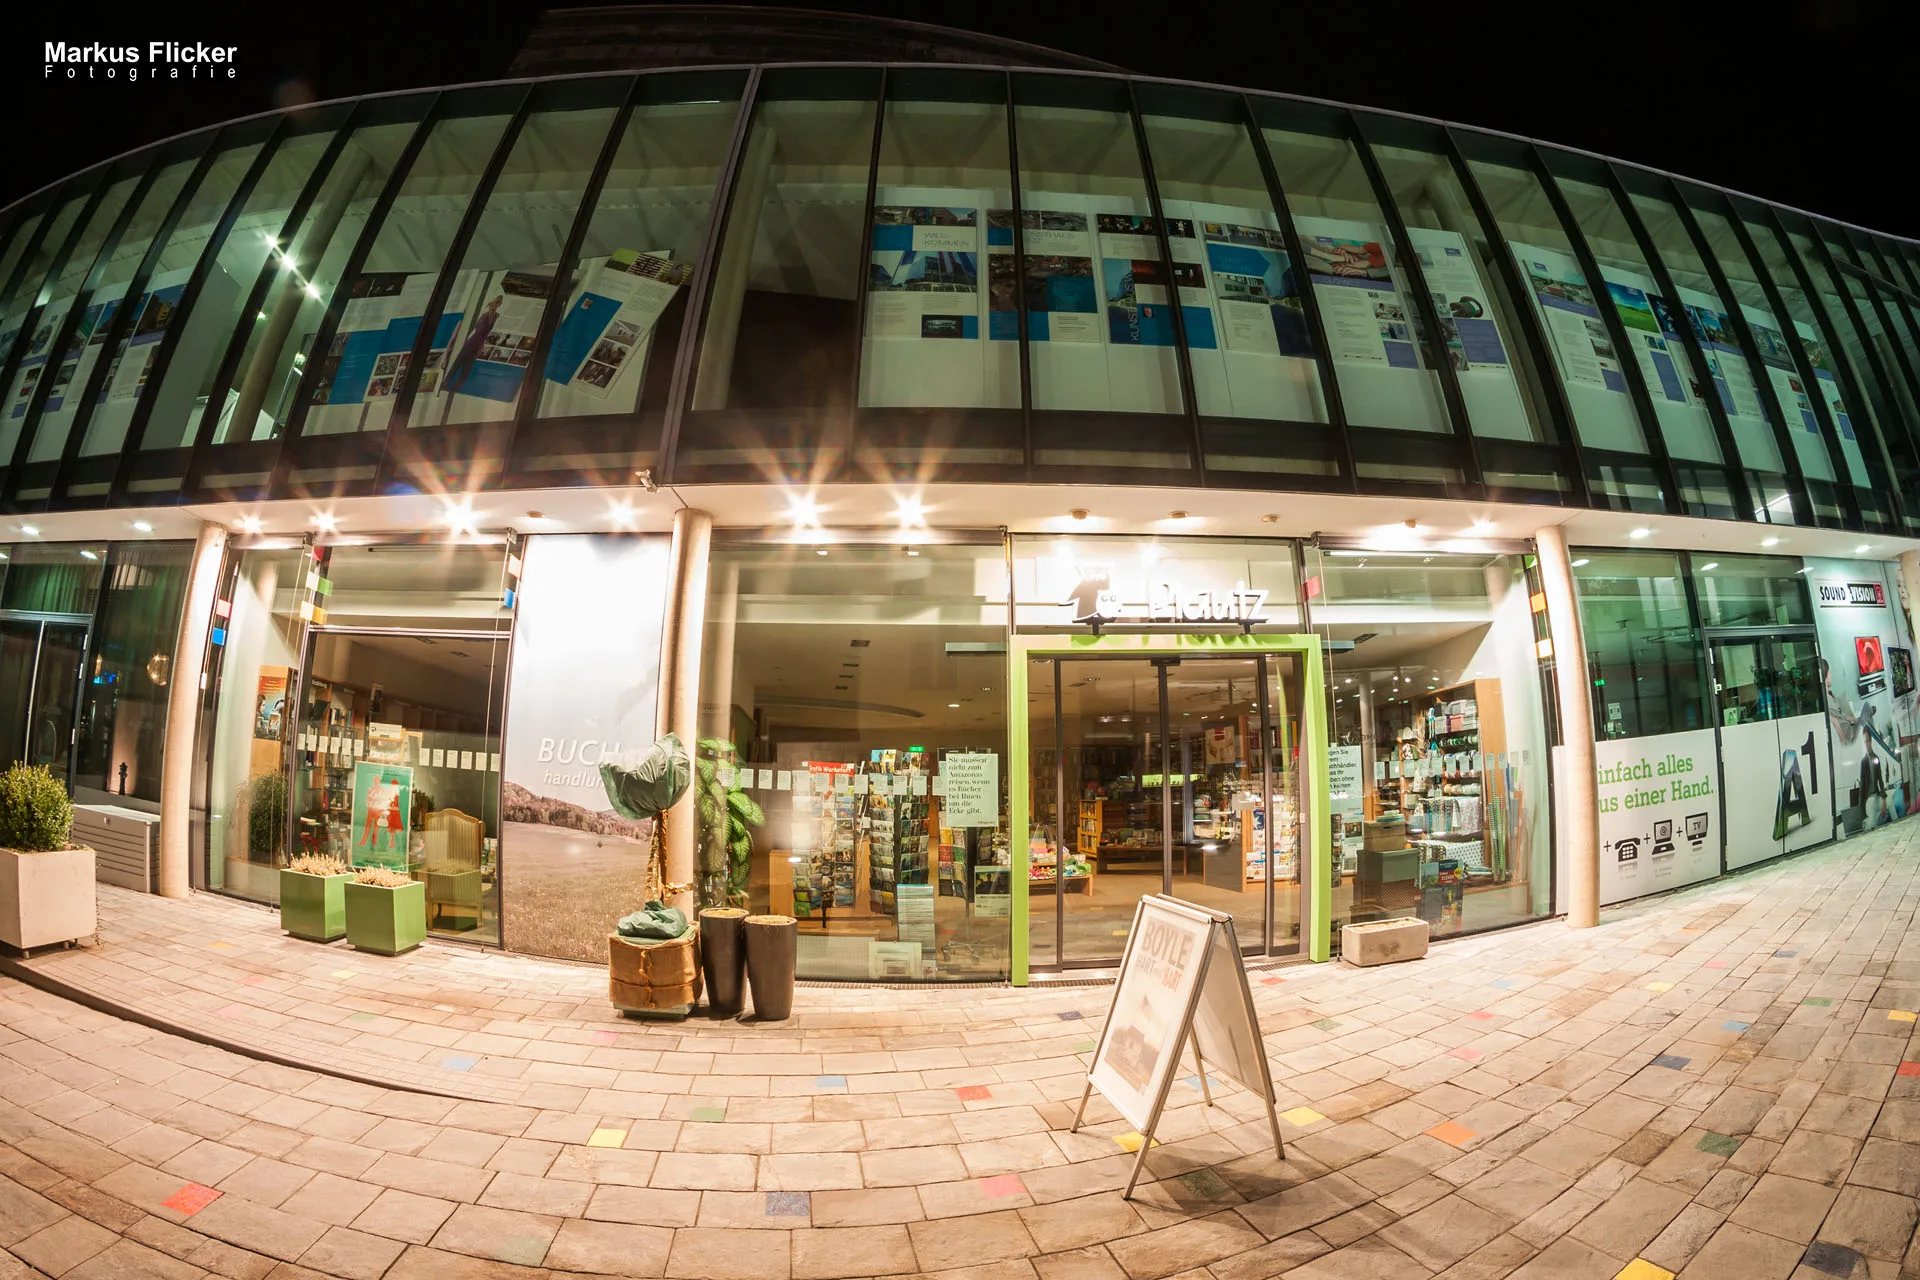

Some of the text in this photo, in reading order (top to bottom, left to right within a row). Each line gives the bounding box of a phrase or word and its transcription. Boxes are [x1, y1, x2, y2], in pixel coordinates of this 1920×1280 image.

[1149, 580, 1271, 621] Plautz
[1820, 586, 1846, 600] SOUND
[538, 737, 621, 767] BUCH
[1598, 754, 1693, 784] infach alles
[1598, 775, 1714, 813] us einer Hand.
[1773, 731, 1818, 841] A1
[1692, 821, 1702, 831] TV
[1142, 920, 1193, 971] BOYLE
